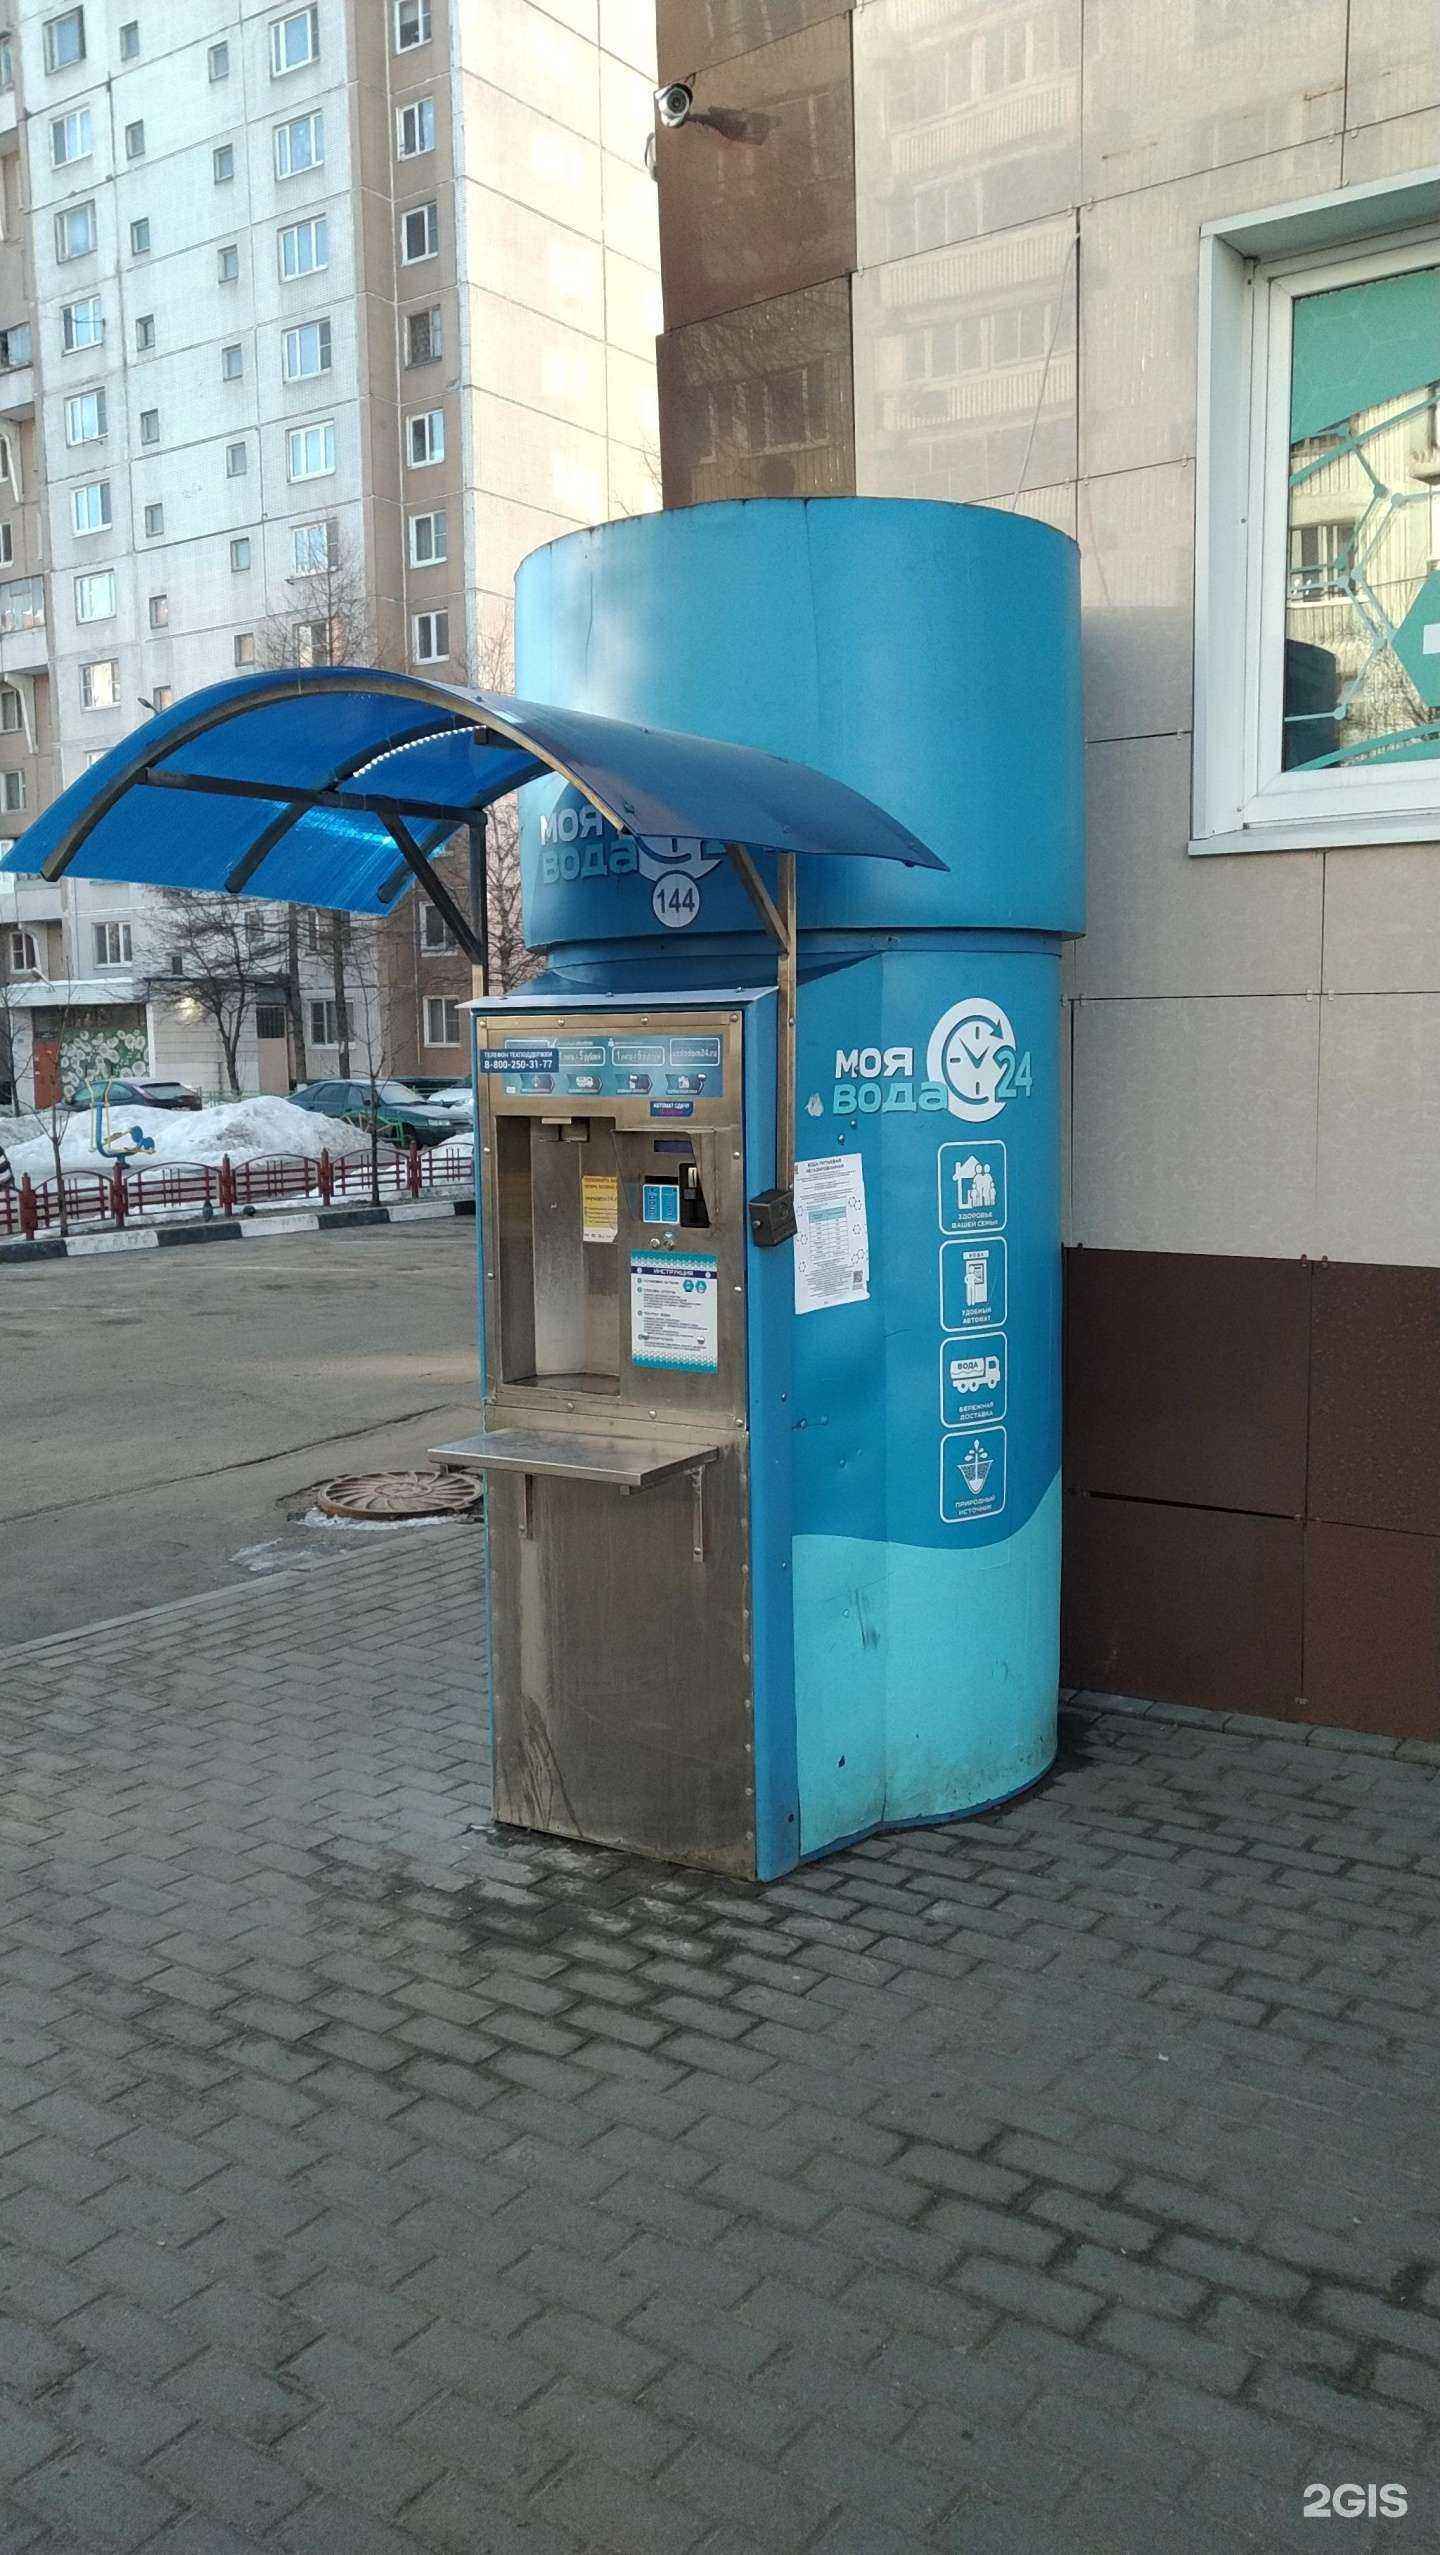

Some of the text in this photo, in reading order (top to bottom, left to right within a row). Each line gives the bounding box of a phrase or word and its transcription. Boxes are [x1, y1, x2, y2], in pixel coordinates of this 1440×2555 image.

[657, 887, 696, 914] 144
[484, 1059, 553, 1069] 8-800-250-31-77
[993, 1045, 1033, 1098] 24
[653, 1268, 694, 1276] ИНСТРУКЦИЯ
[962, 1316, 991, 1324] АВТОМАТ
[957, 1362, 979, 1370] ВОДА
[958, 1402, 994, 1413] БЕРЕЖНАЯ
[960, 1411, 994, 1421] ДОСТАВКА
[955, 1495, 996, 1508] ПРИРОДНЫЙ
